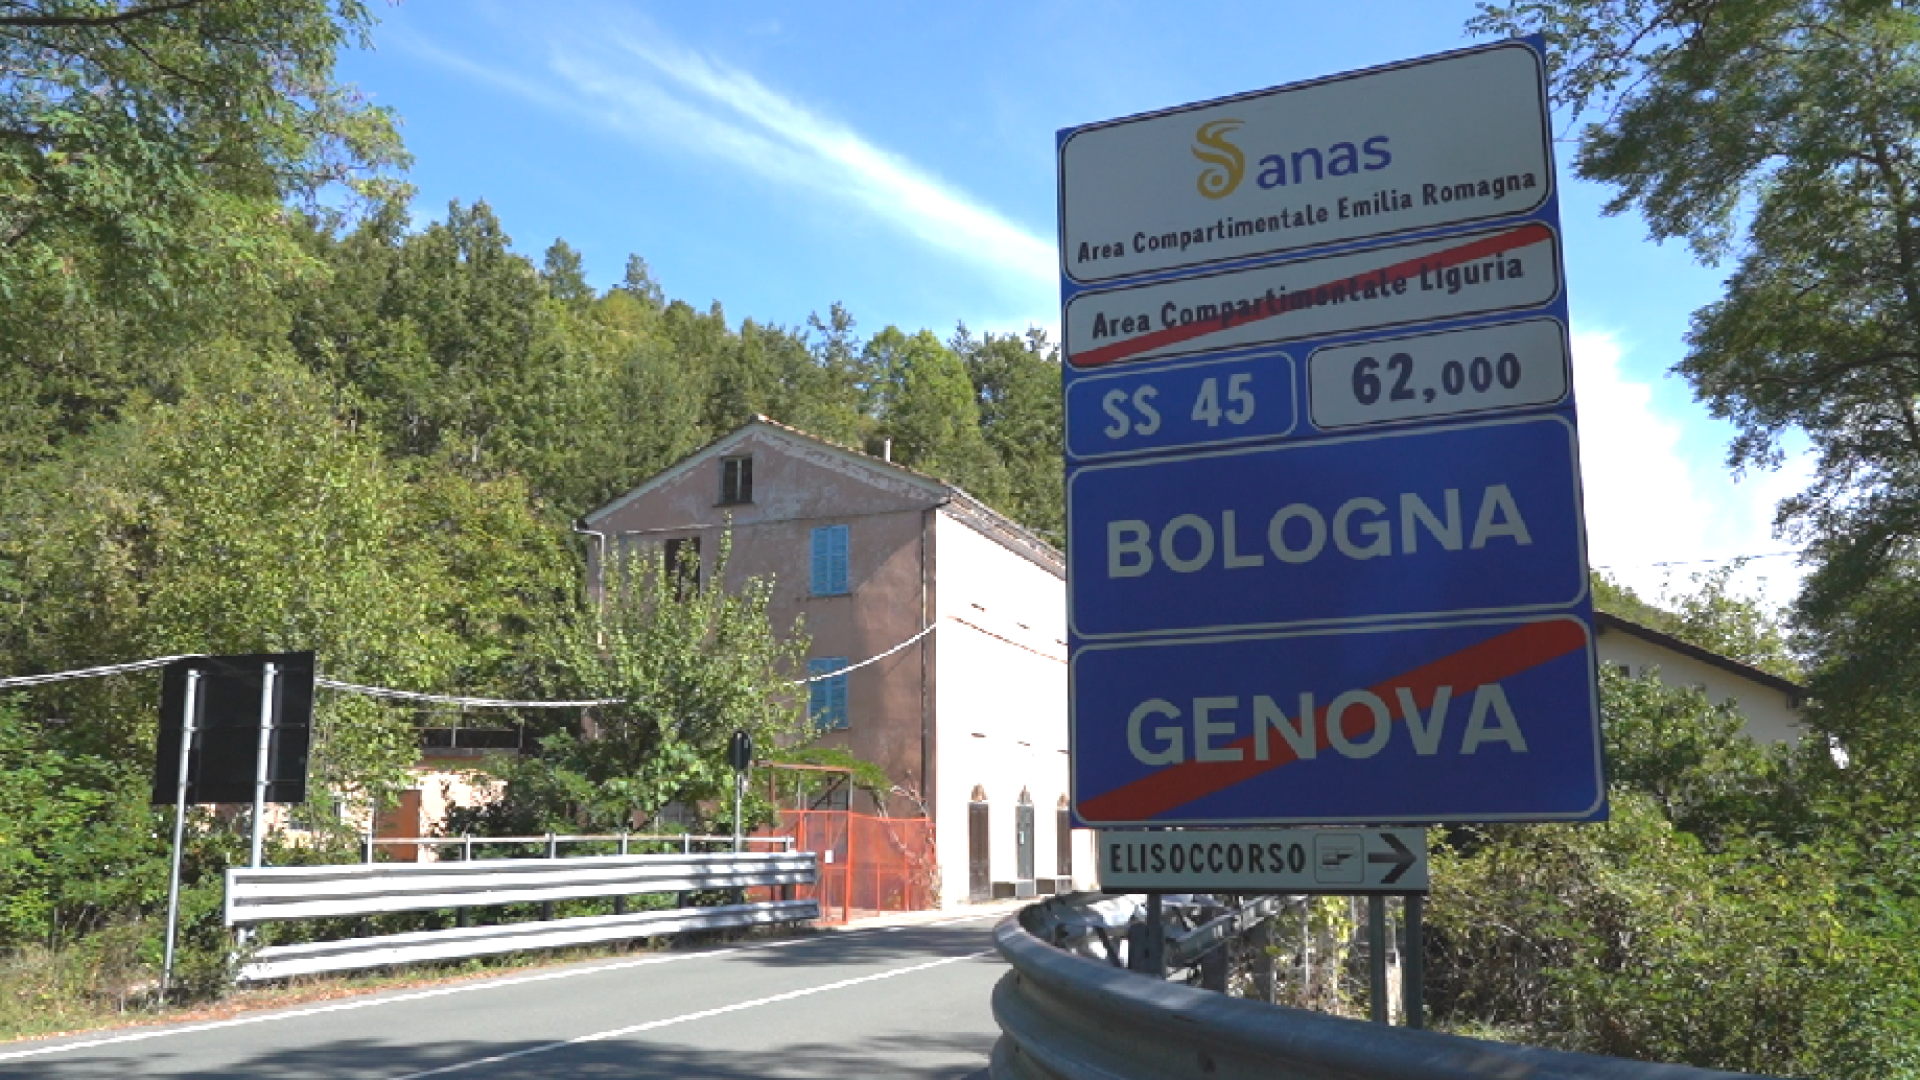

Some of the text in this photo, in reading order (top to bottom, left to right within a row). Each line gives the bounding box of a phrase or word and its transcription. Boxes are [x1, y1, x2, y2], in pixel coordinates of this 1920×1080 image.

[1256, 134, 1392, 190] anas
[1078, 171, 1536, 263] Area Compartimentale Emilia Romagna
[1092, 254, 1523, 338] Area Compartimentale Liguria
[1102, 372, 1256, 439] SS 45
[1352, 352, 1521, 406] 62,000
[1107, 483, 1533, 579] BOLOGNA
[1126, 682, 1529, 766] GENOVA
[1109, 842, 1307, 875] ELISOCCORSO
